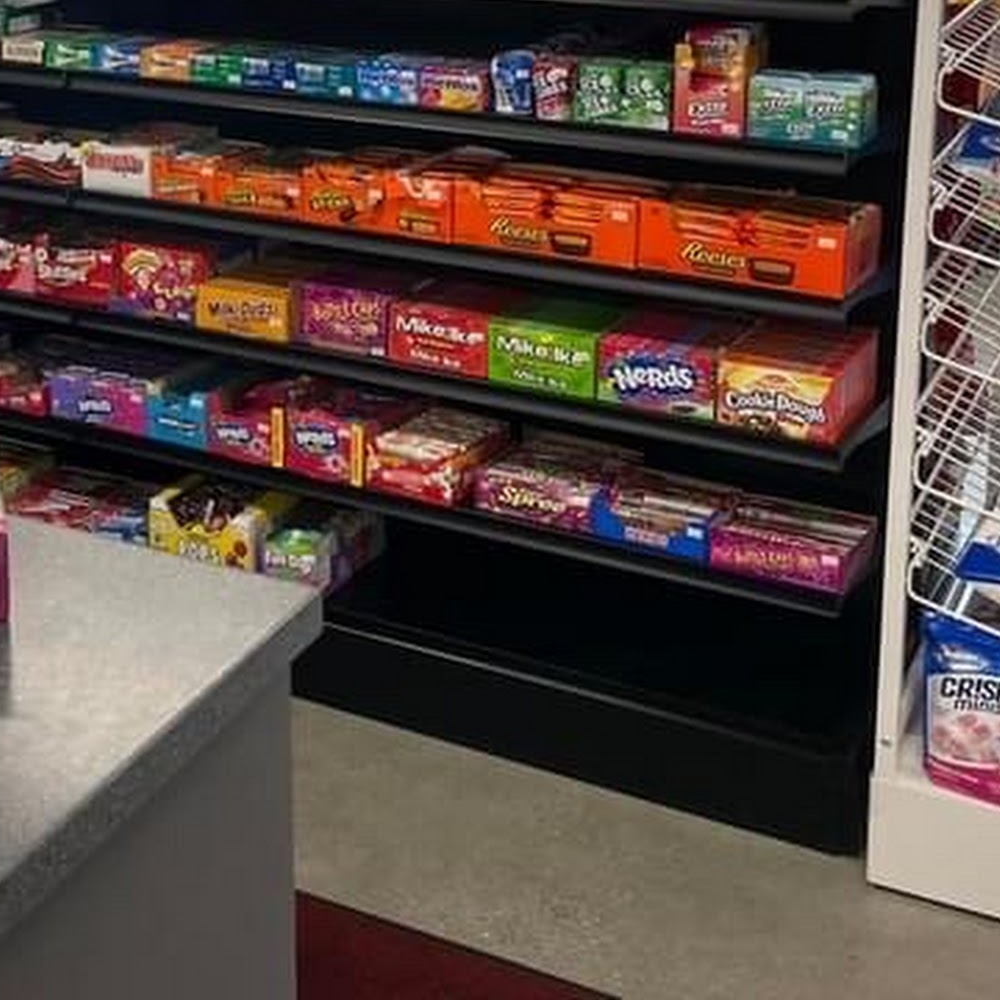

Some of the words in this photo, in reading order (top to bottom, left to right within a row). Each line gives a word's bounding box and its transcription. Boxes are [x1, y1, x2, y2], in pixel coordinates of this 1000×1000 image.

[396, 315, 445, 336] Mike
[496, 335, 549, 358] Mike
[552, 344, 591, 368] Ike
